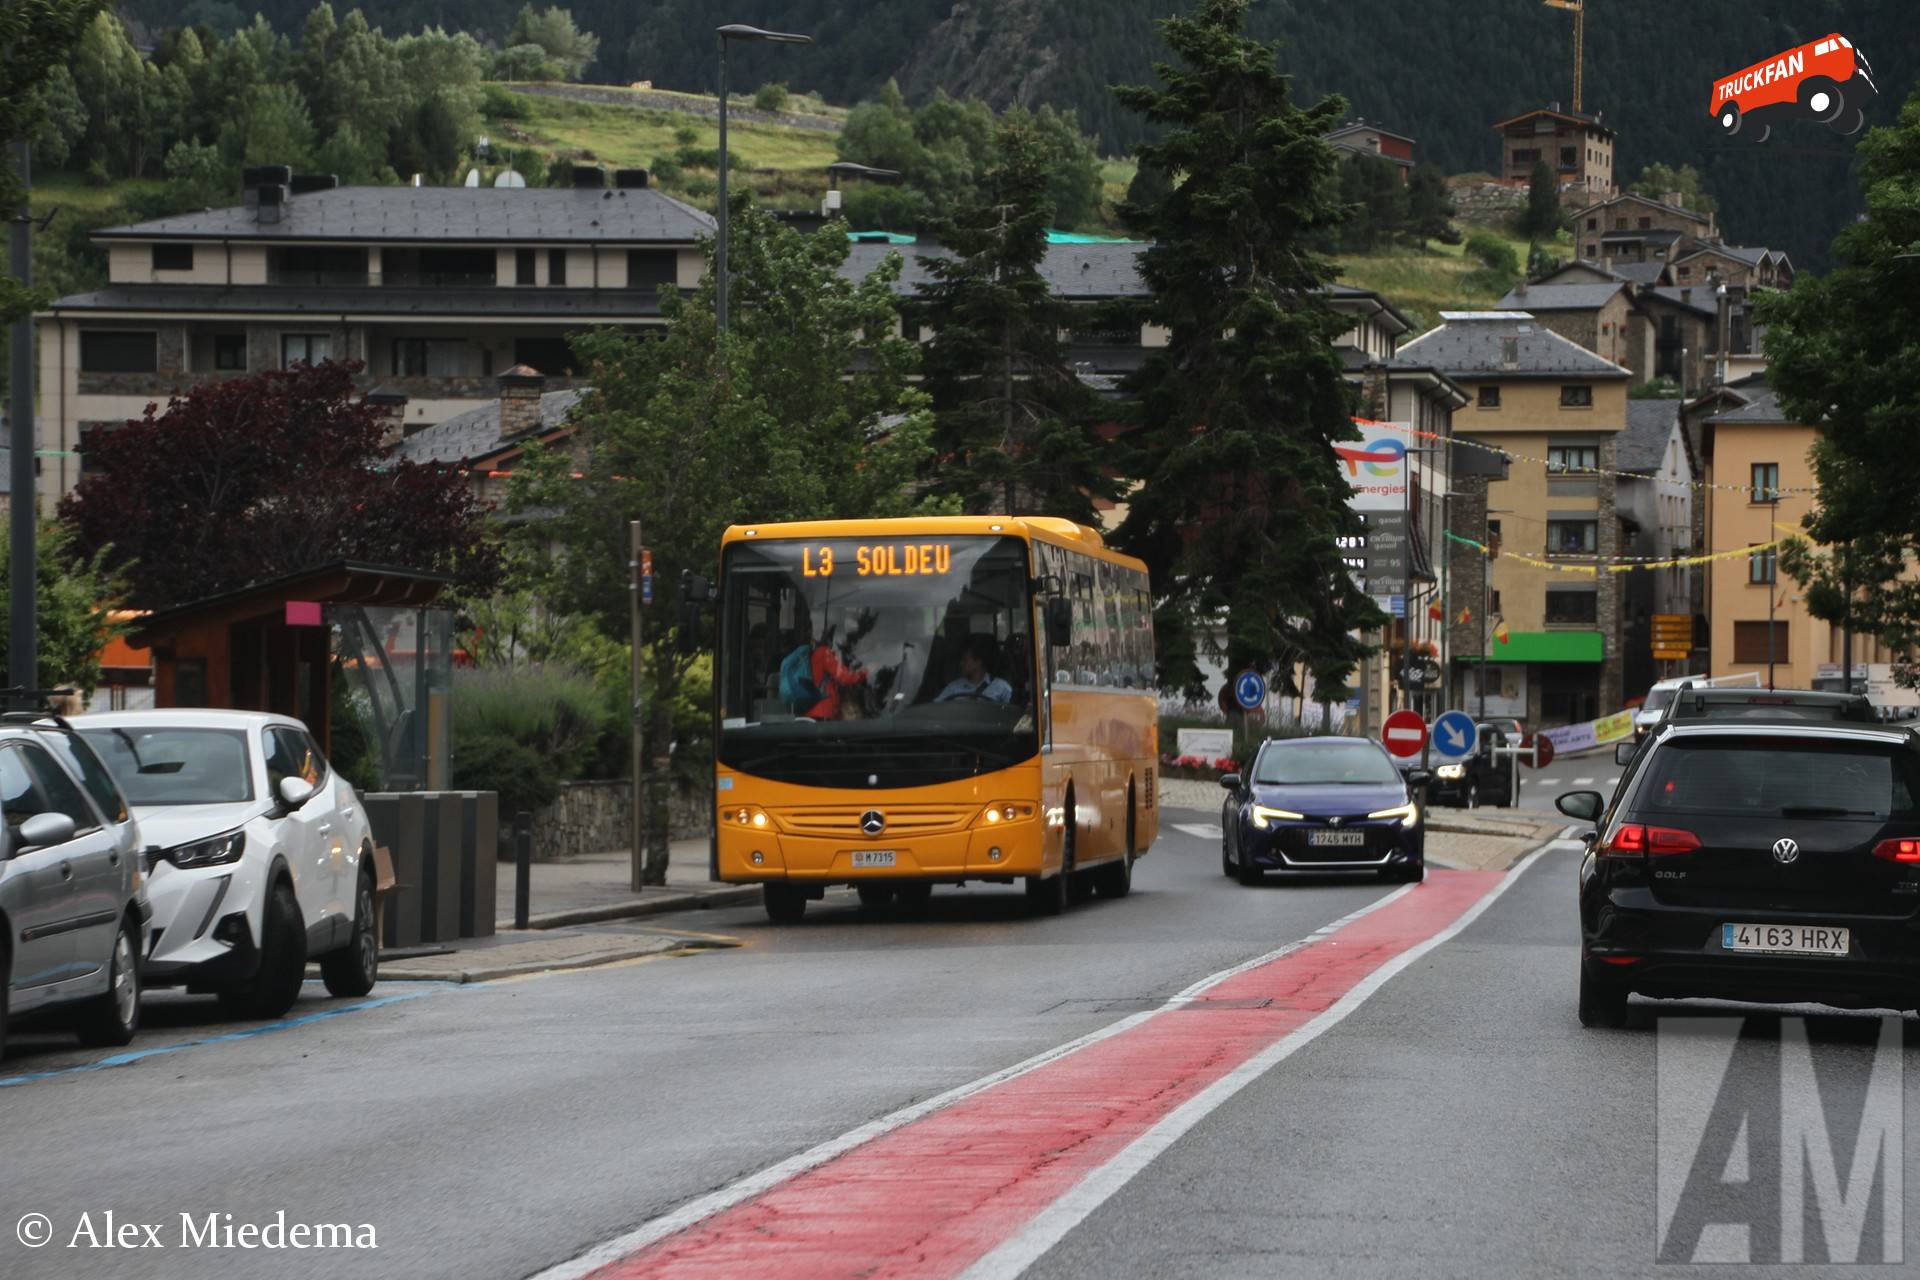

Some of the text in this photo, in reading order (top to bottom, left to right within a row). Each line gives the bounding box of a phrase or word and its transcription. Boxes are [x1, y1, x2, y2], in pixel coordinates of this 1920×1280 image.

[803, 544, 950, 577] L3 SOLDEU
[1654, 870, 1687, 880] GOLF
[1738, 927, 1843, 950] 4163 HRX
